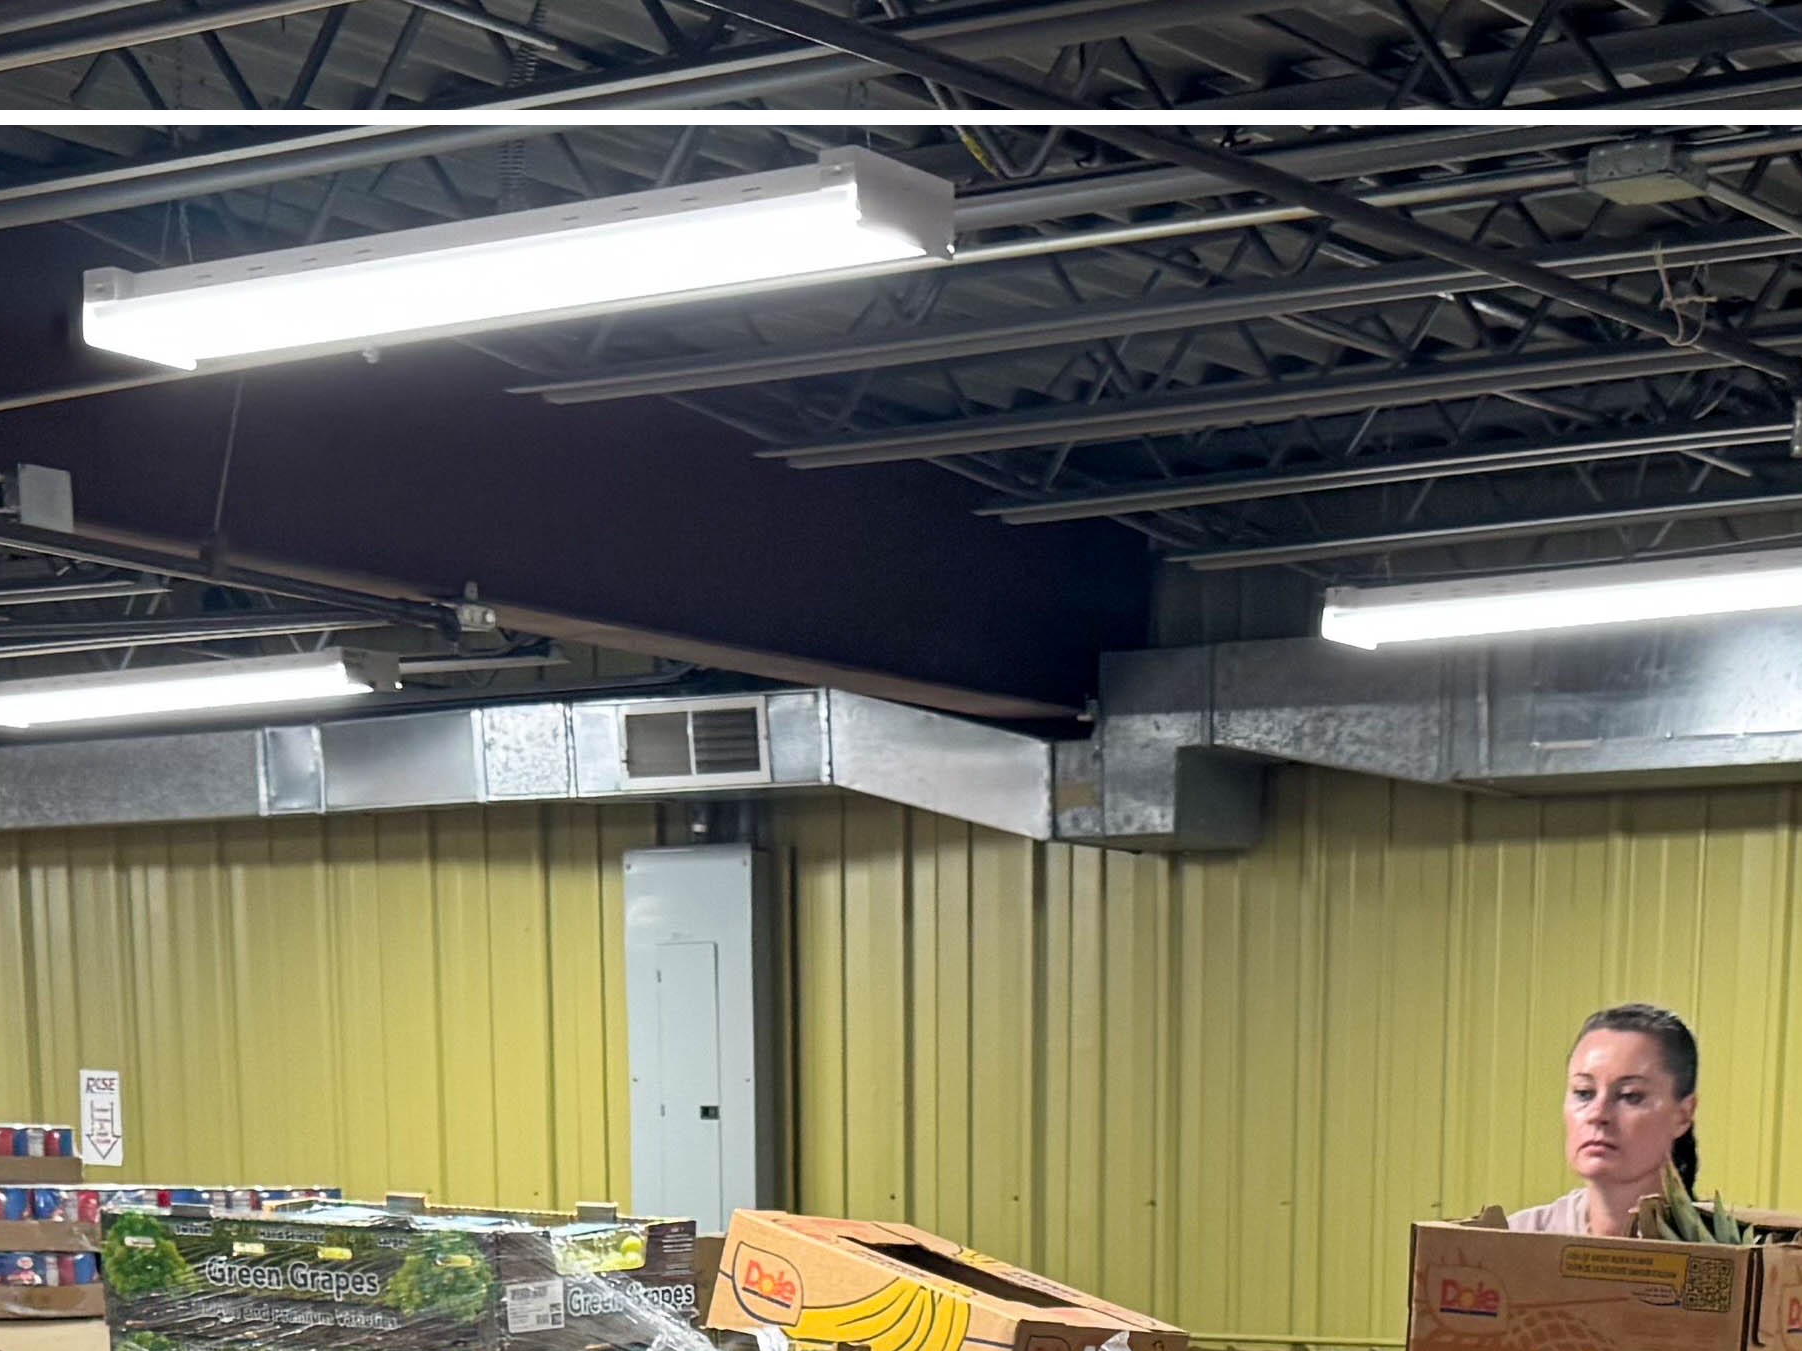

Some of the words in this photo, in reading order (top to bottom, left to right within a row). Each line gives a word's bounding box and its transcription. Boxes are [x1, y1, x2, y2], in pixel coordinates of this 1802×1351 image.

[206, 1256, 282, 1289] Green
[288, 1262, 379, 1300] Grapes
[744, 1260, 796, 1301] Dole
[1441, 1278, 1499, 1310] Dole
